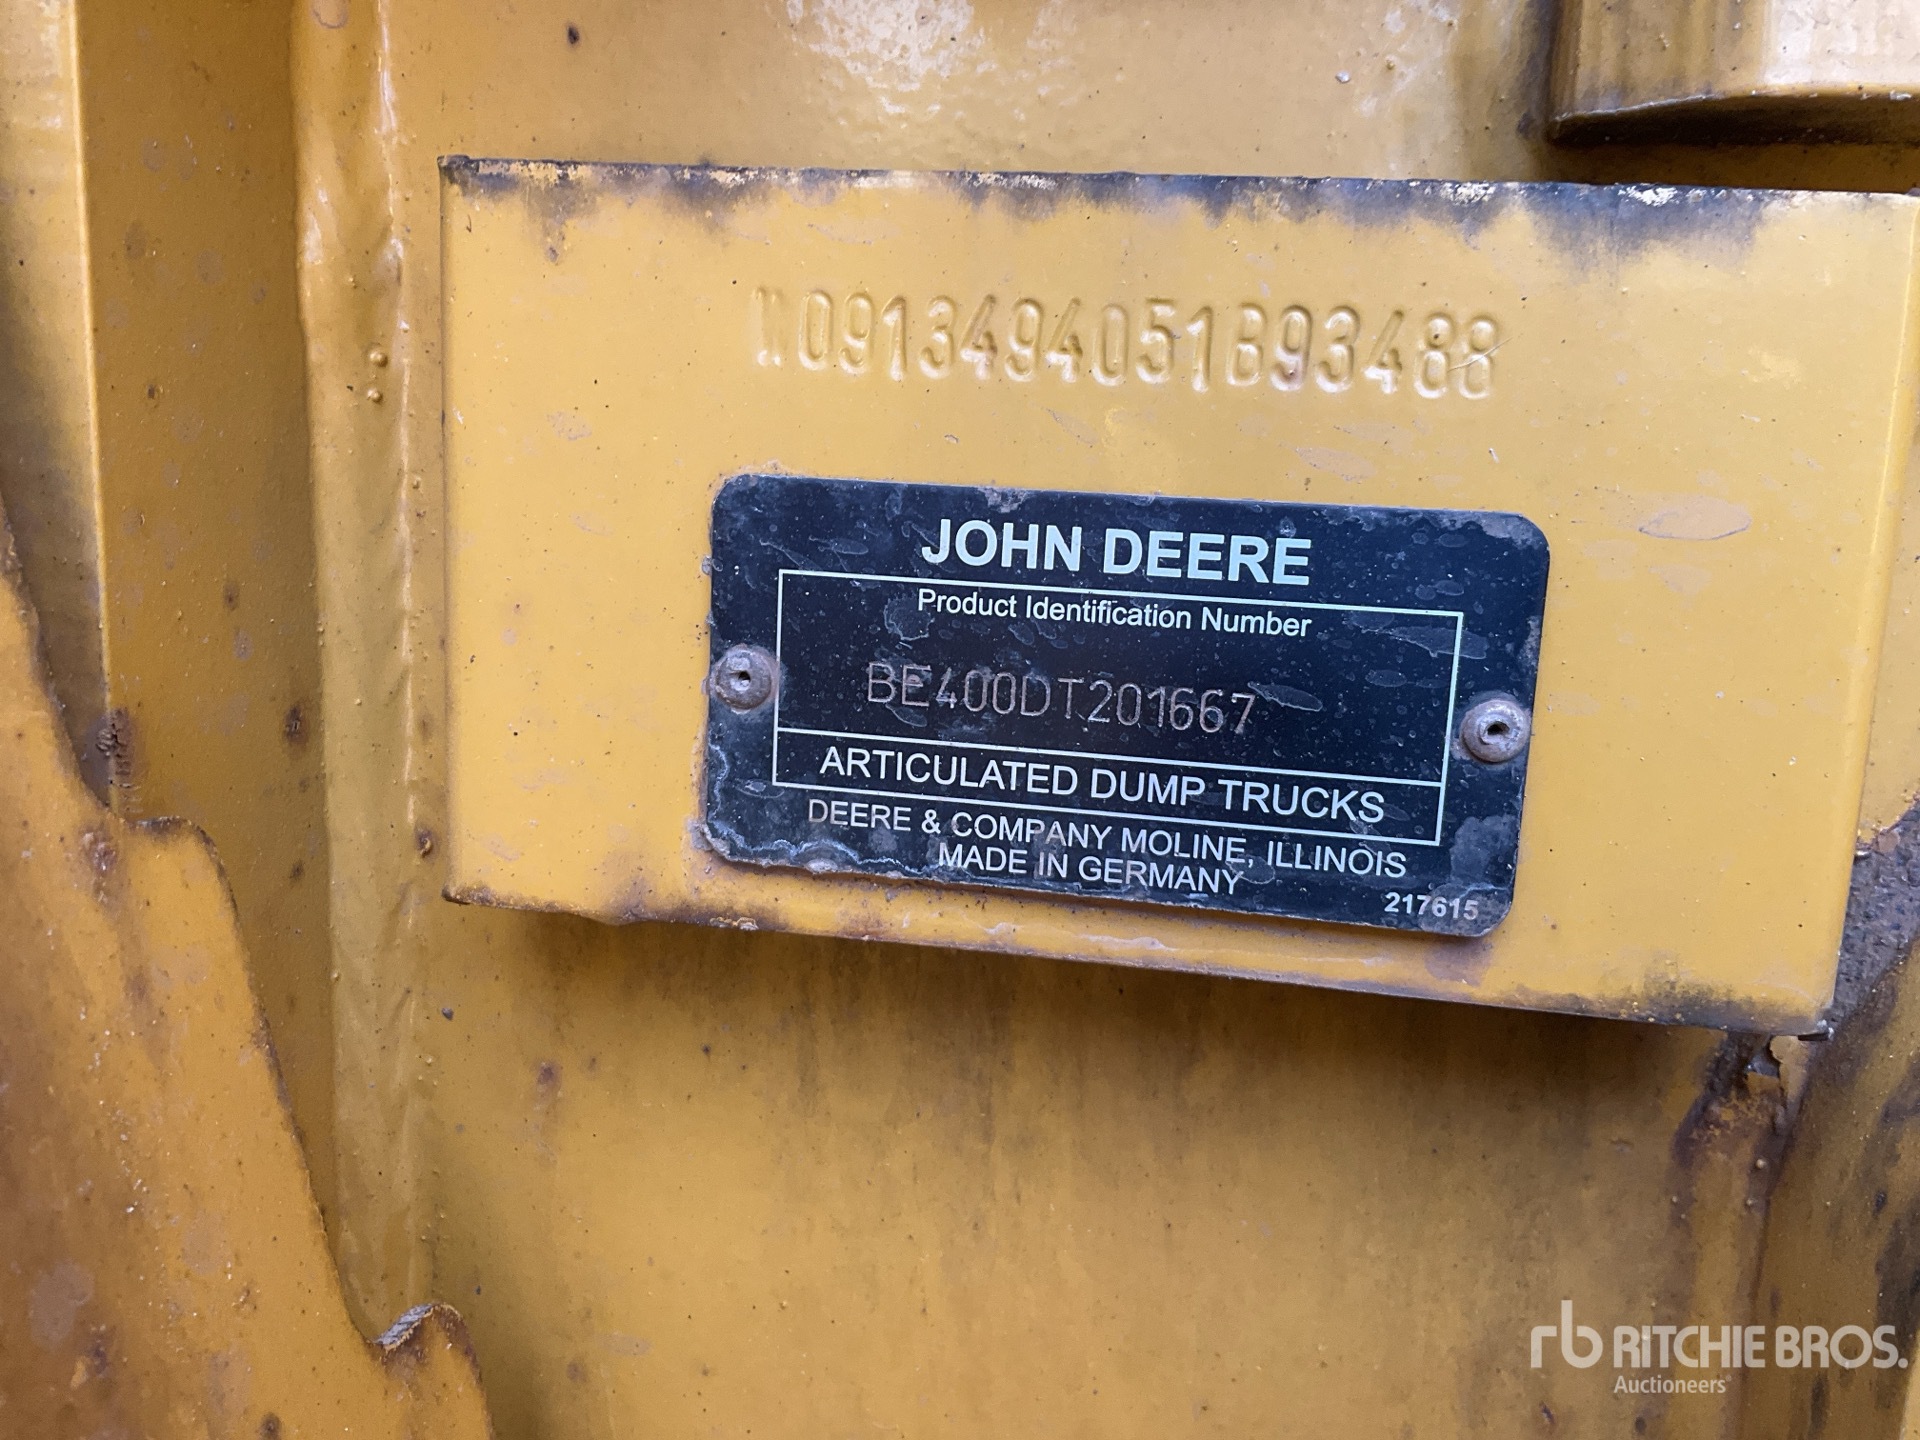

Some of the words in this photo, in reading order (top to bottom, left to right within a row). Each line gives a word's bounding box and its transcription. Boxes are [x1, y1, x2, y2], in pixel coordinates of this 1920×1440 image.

[921, 518, 1082, 571] JOHN
[1103, 528, 1312, 585] DEERE
[918, 588, 1017, 618] Product
[1026, 595, 1192, 629] Identification
[1201, 606, 1312, 637] Number
[866, 661, 1256, 735] BE400DT201667
[819, 746, 1078, 795] ARTICULATED
[1090, 769, 1206, 806] DUMP
[1218, 779, 1385, 824] TRUCKS
[808, 799, 912, 831] DEERE
[921, 808, 941, 835] &
[951, 811, 1113, 849] COMPANY
[1120, 828, 1255, 868] MOLINE,
[1267, 840, 1407, 878] ILLINOIS
[938, 843, 1028, 874] MADE
[1037, 851, 1068, 878] IN
[1078, 858, 1244, 895] GERMANY
[1384, 891, 1480, 922] 217615
